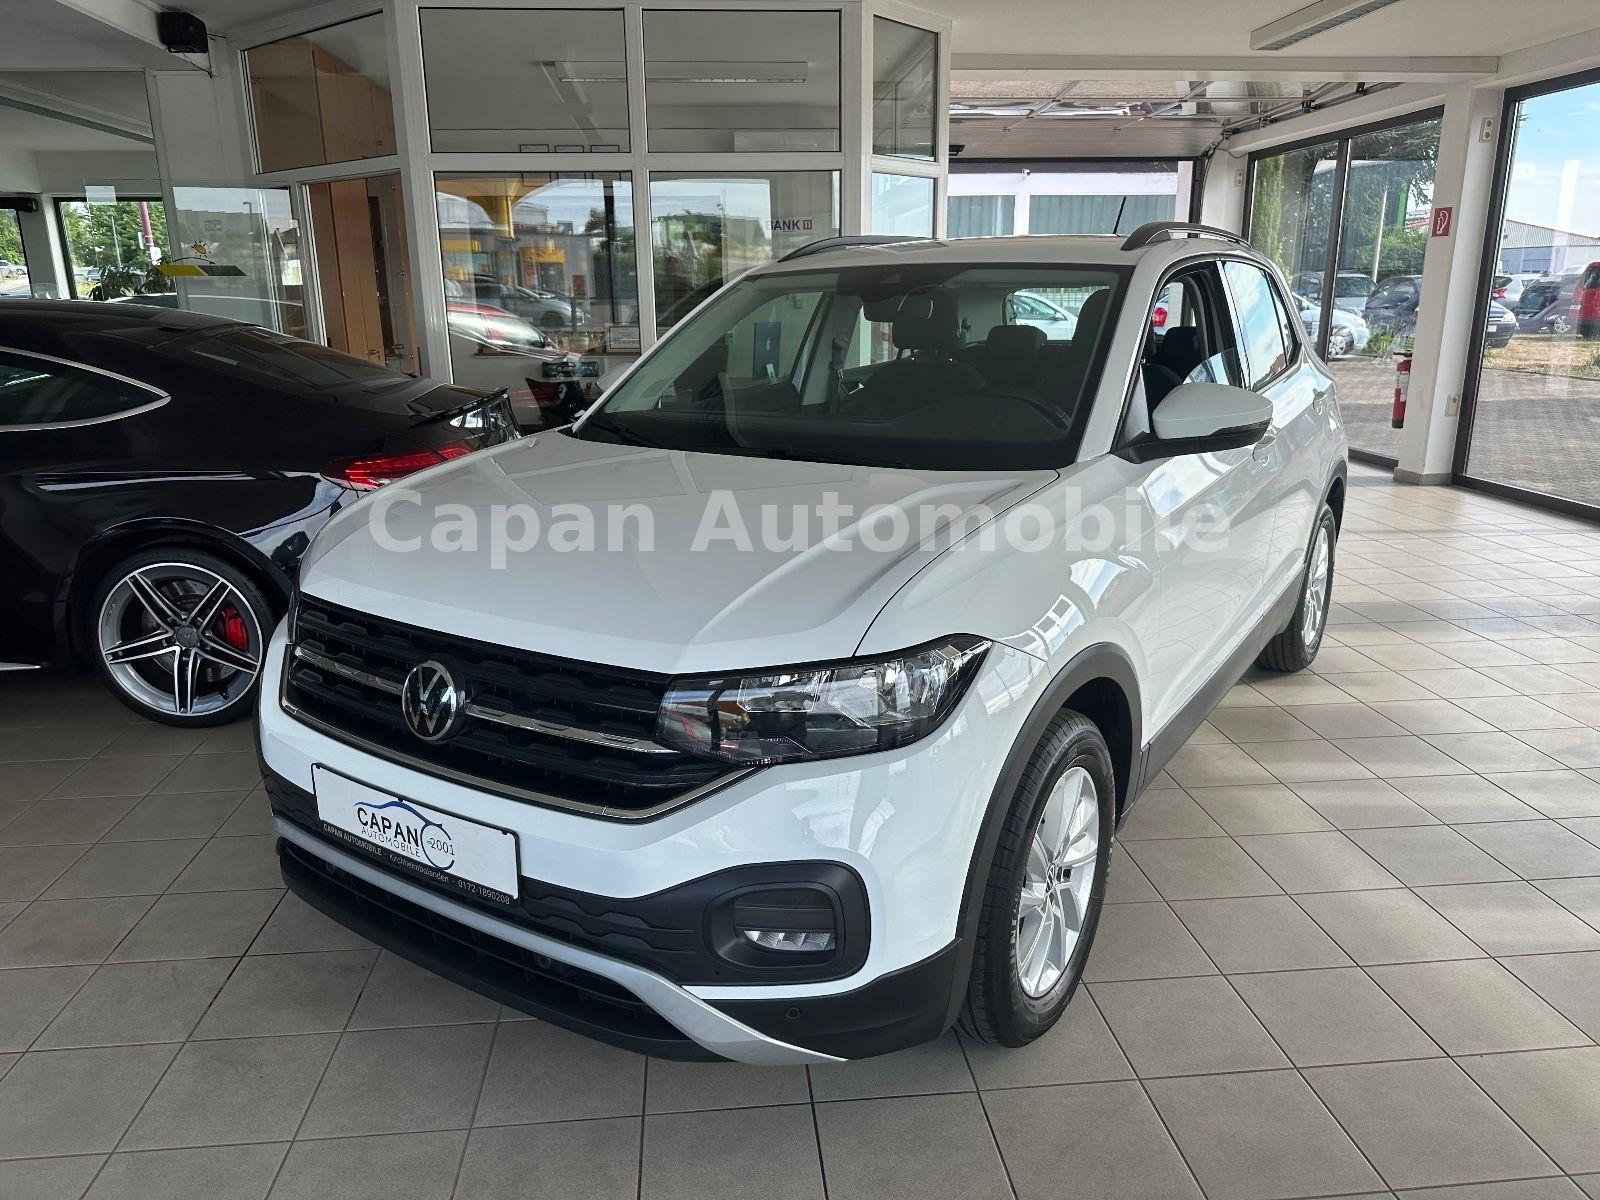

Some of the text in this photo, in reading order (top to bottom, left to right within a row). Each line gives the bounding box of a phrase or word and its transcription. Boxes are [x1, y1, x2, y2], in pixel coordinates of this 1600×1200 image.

[766, 220, 800, 231] BANK
[323, 823, 343, 838] CAPAN
[343, 832, 382, 856] AUTOMOBILE
[357, 807, 420, 848] CAPAN
[361, 826, 421, 858] AUTOMOBILE
[429, 837, 455, 856] 2001
